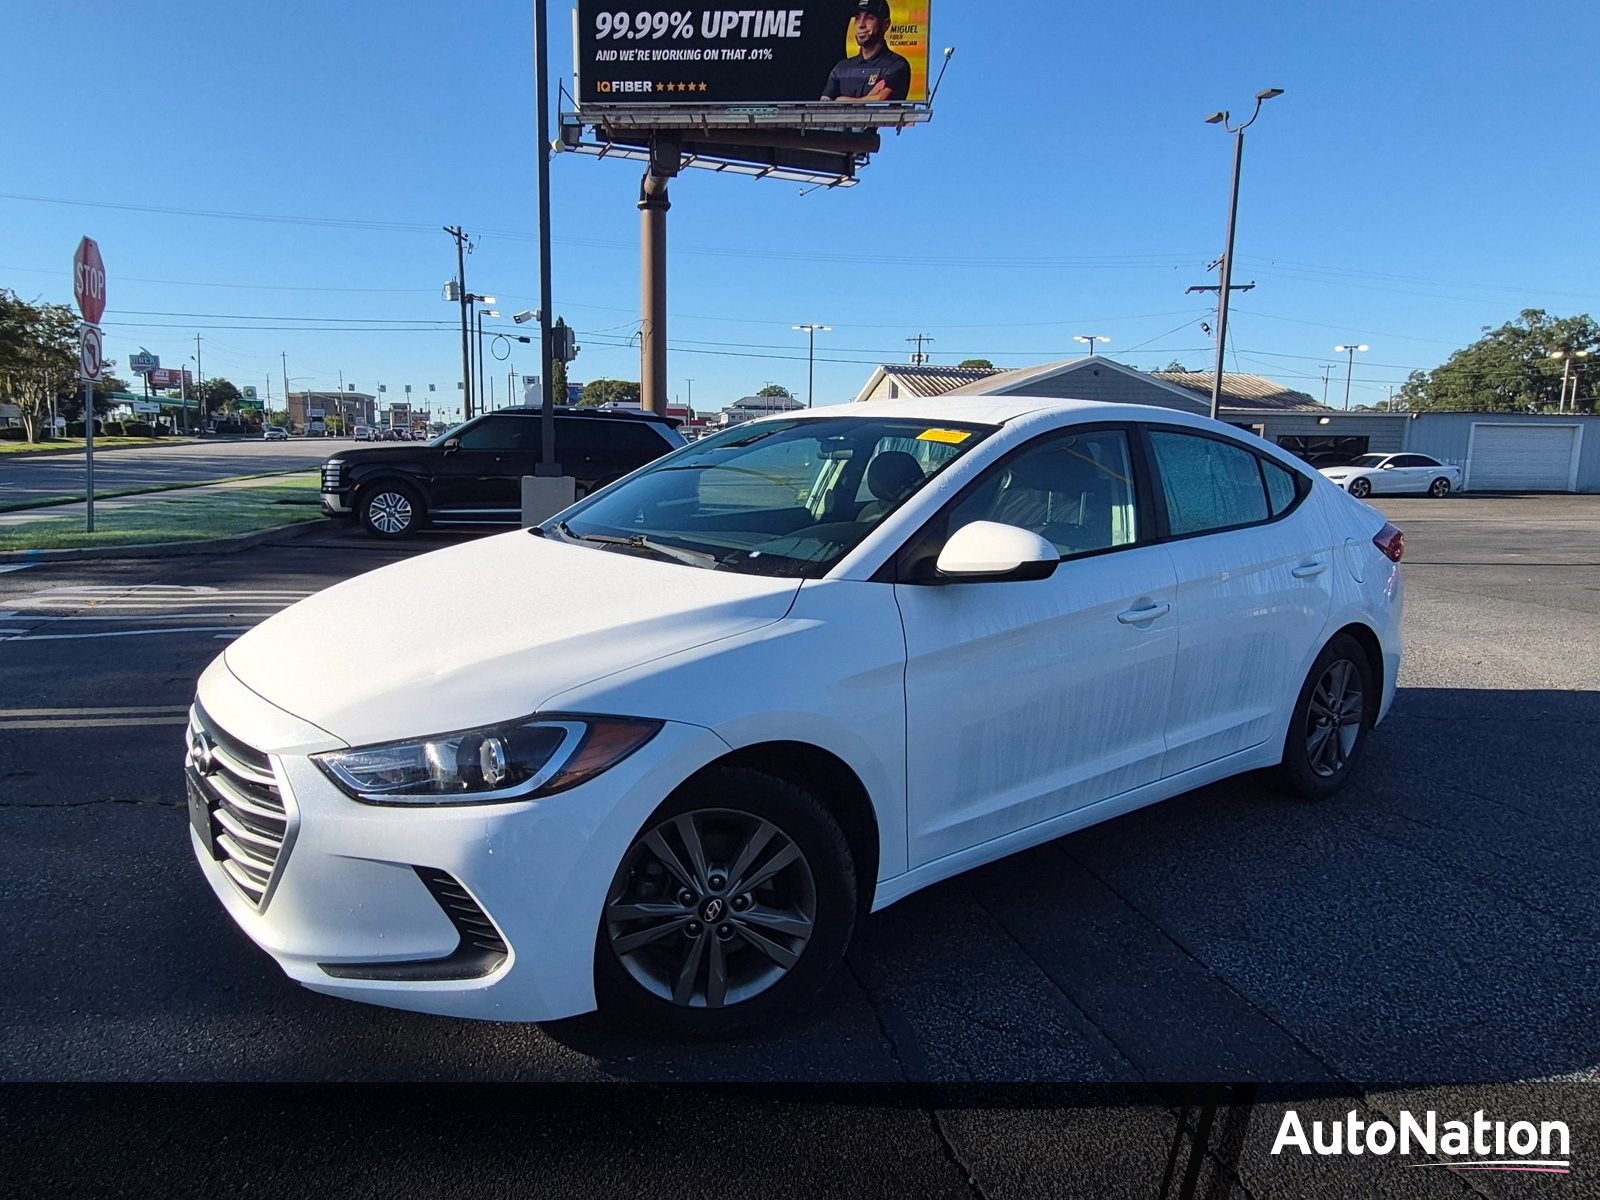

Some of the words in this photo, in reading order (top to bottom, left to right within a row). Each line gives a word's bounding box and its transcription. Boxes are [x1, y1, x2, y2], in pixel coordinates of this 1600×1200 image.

[595, 11, 694, 40] 99.99%
[701, 10, 804, 39] UPTIME
[890, 25, 918, 34] MIGUEL
[595, 49, 618, 61] AND
[619, 48, 651, 61] WE'RE
[652, 49, 702, 61] WORKING
[703, 49, 719, 60] ON
[720, 48, 748, 60] THAT
[747, 48, 773, 60] .01%
[76, 262, 105, 300] STOP
